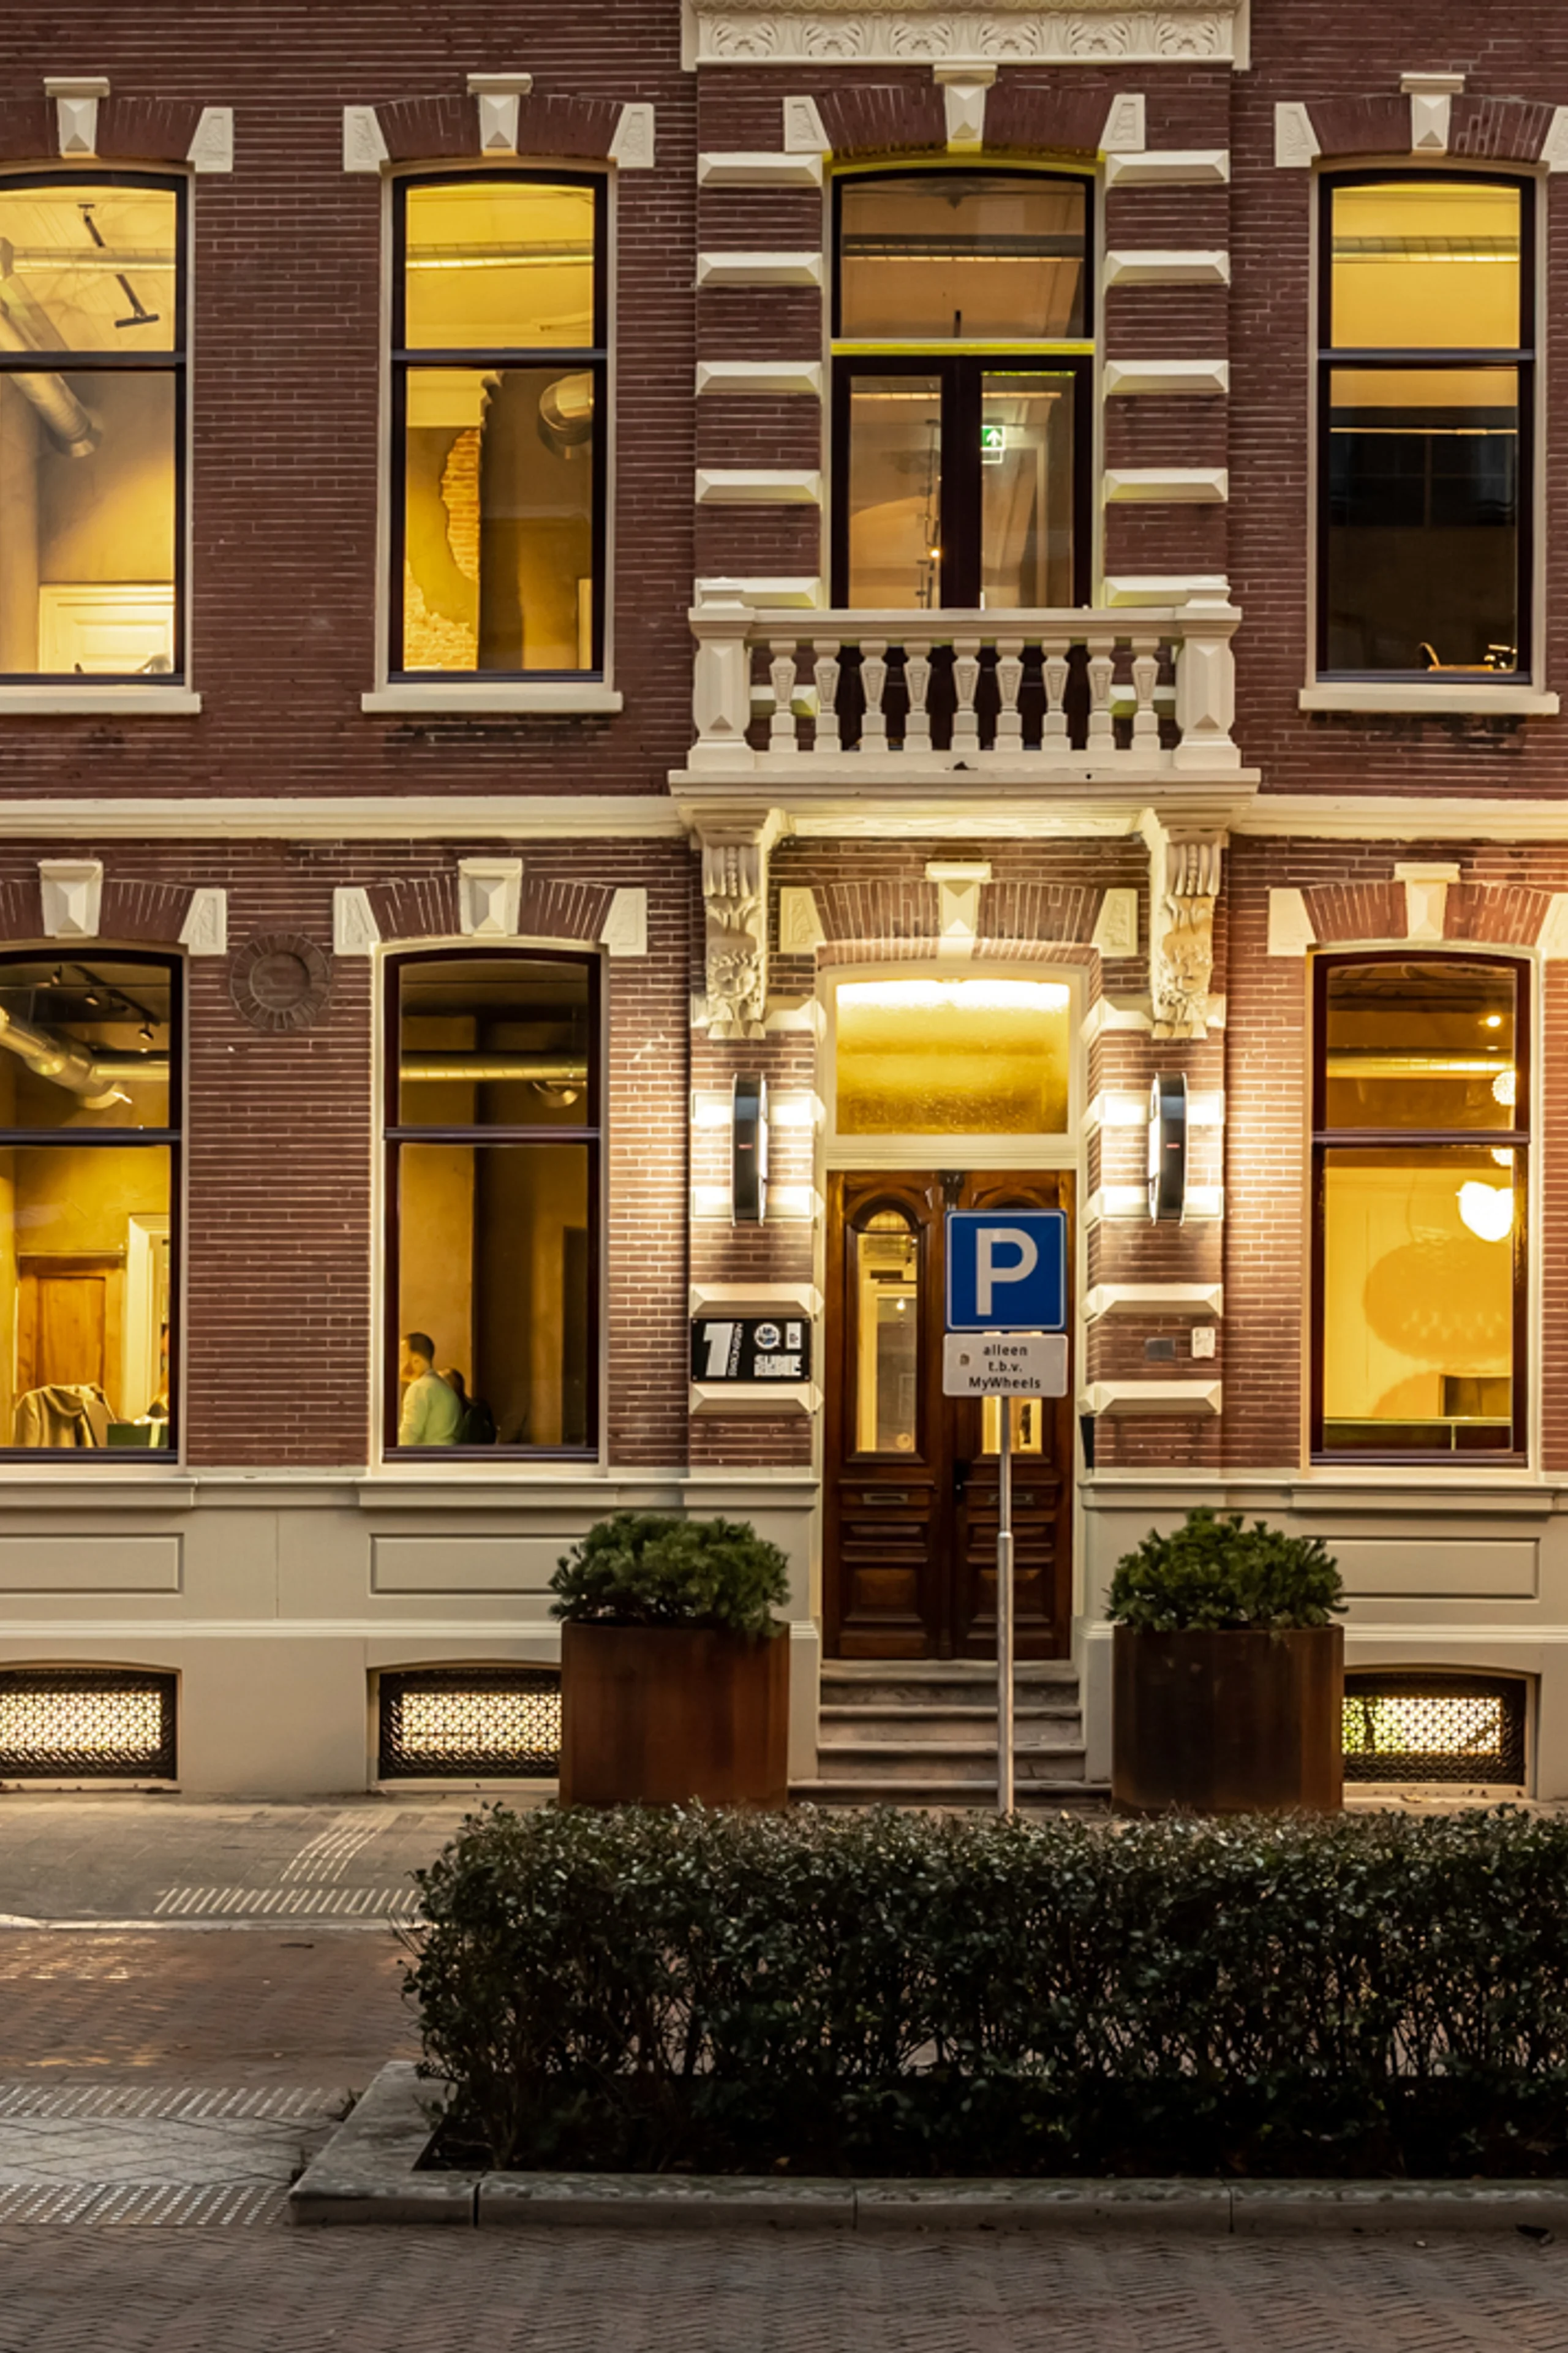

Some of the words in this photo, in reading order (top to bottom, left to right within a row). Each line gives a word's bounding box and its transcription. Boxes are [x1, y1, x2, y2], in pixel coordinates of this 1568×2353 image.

[976, 1228, 1038, 1316] P
[982, 1345, 1028, 1356] alleen
[988, 1361, 1022, 1372] t.b.v.
[968, 1377, 1041, 1390] MyWheels
